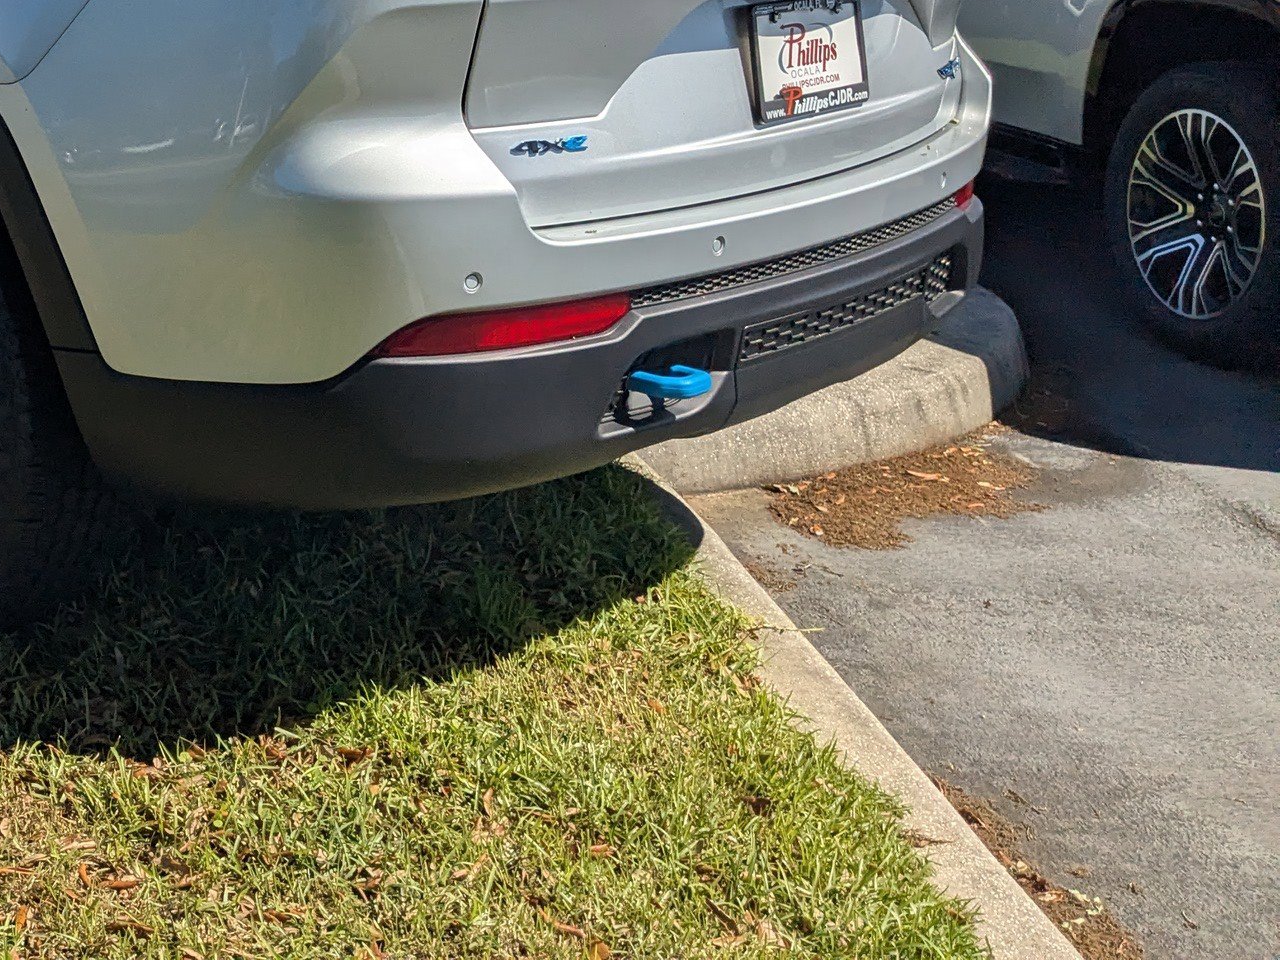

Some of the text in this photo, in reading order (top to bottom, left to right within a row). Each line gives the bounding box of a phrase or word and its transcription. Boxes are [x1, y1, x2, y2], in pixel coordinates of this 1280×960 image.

[780, 22, 838, 72] Phillips
[790, 65, 821, 79] OCALA
[765, 86, 869, 120] www.PhillipsCJDR.com
